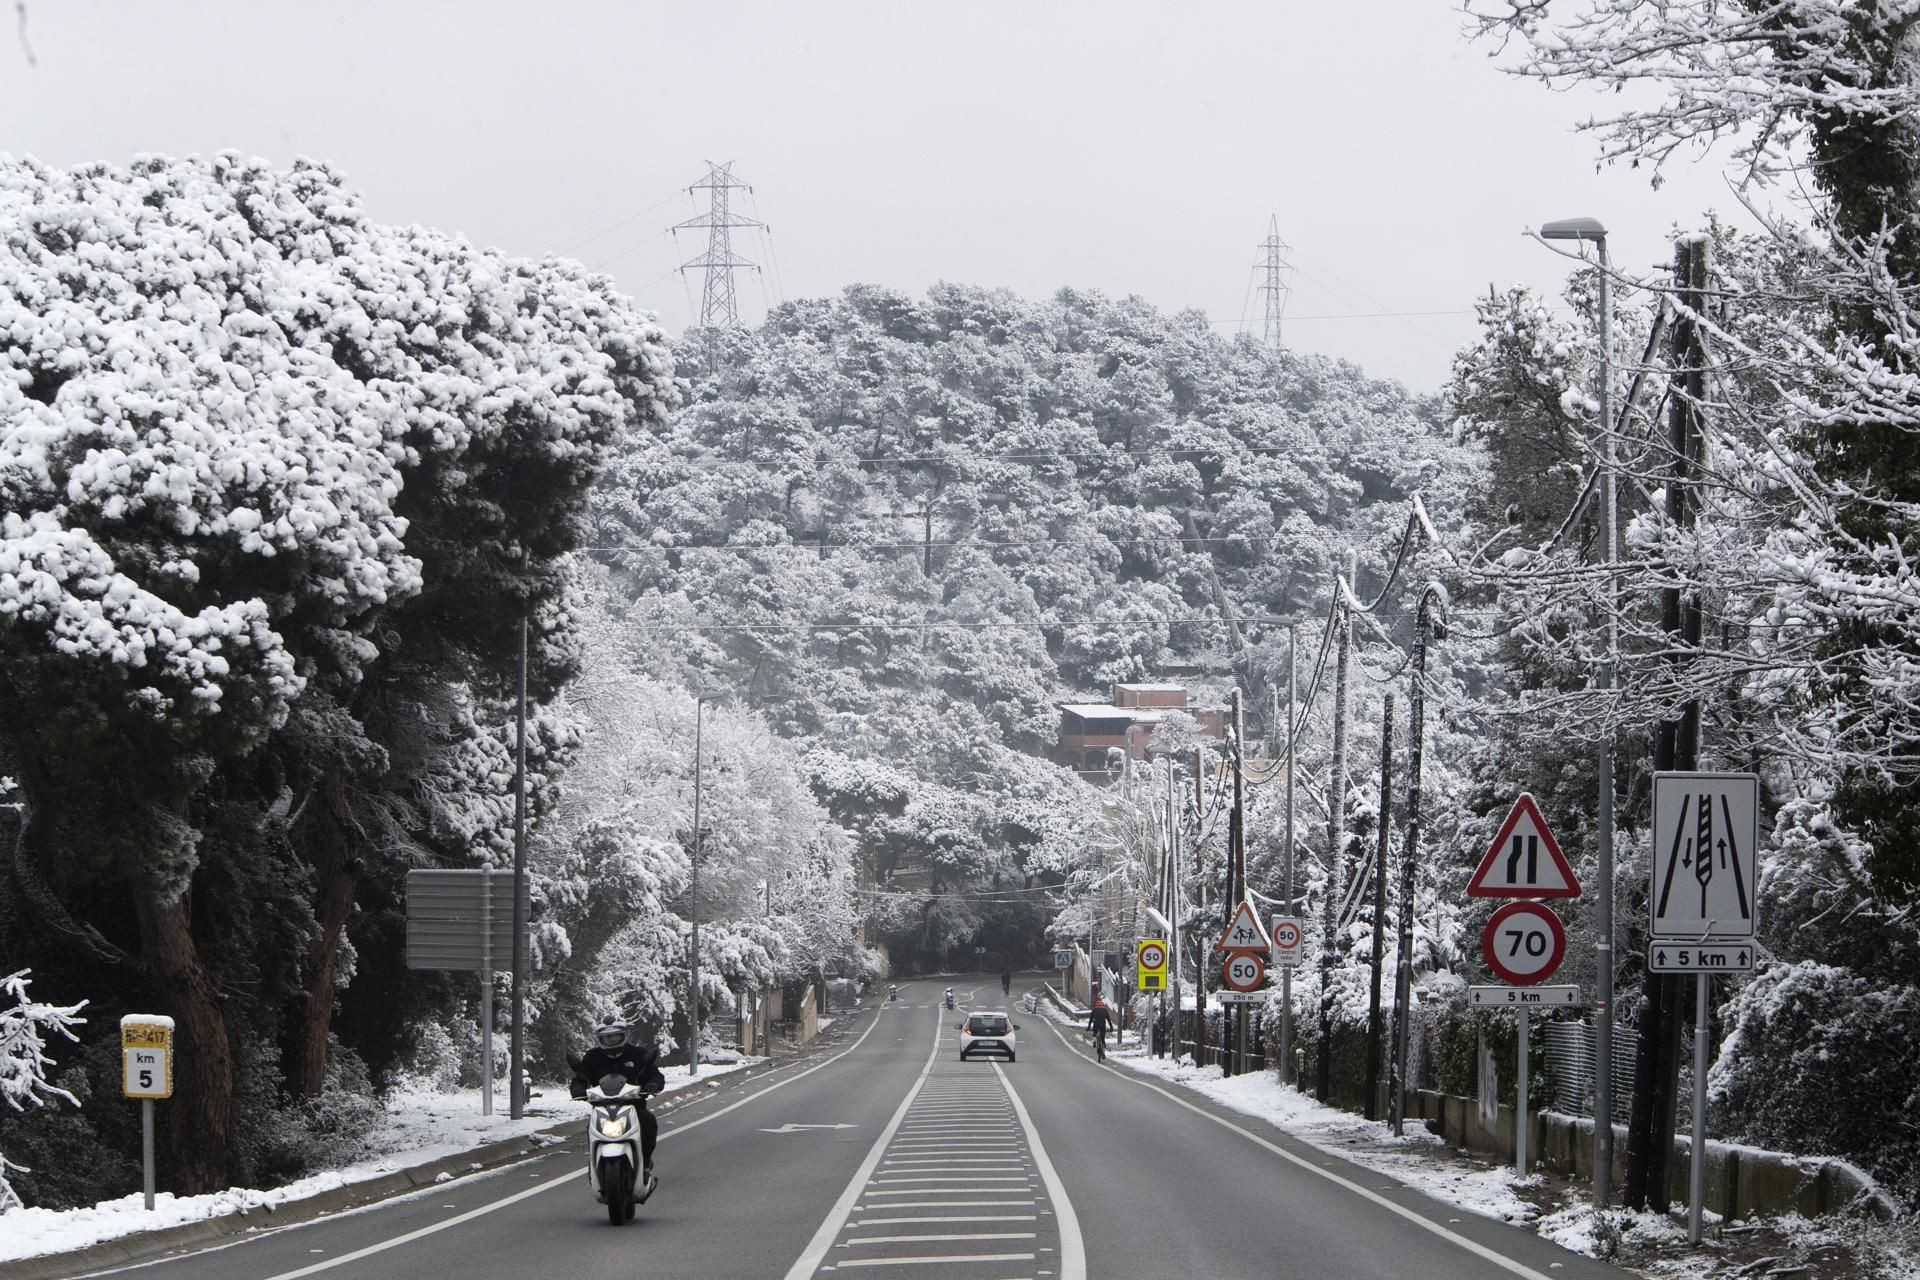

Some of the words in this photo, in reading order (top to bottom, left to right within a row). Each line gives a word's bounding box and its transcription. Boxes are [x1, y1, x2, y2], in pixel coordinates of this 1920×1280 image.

[1280, 931, 1294, 940] 50
[1505, 930, 1547, 957] 70
[1145, 953, 1160, 961] 50
[1678, 951, 1689, 966] 5
[1698, 950, 1726, 966] km
[1233, 964, 1255, 978] 50
[1508, 992, 1516, 1002] 5
[1521, 991, 1540, 1002] km
[136, 1052, 155, 1063] km
[139, 1070, 153, 1089] 5
